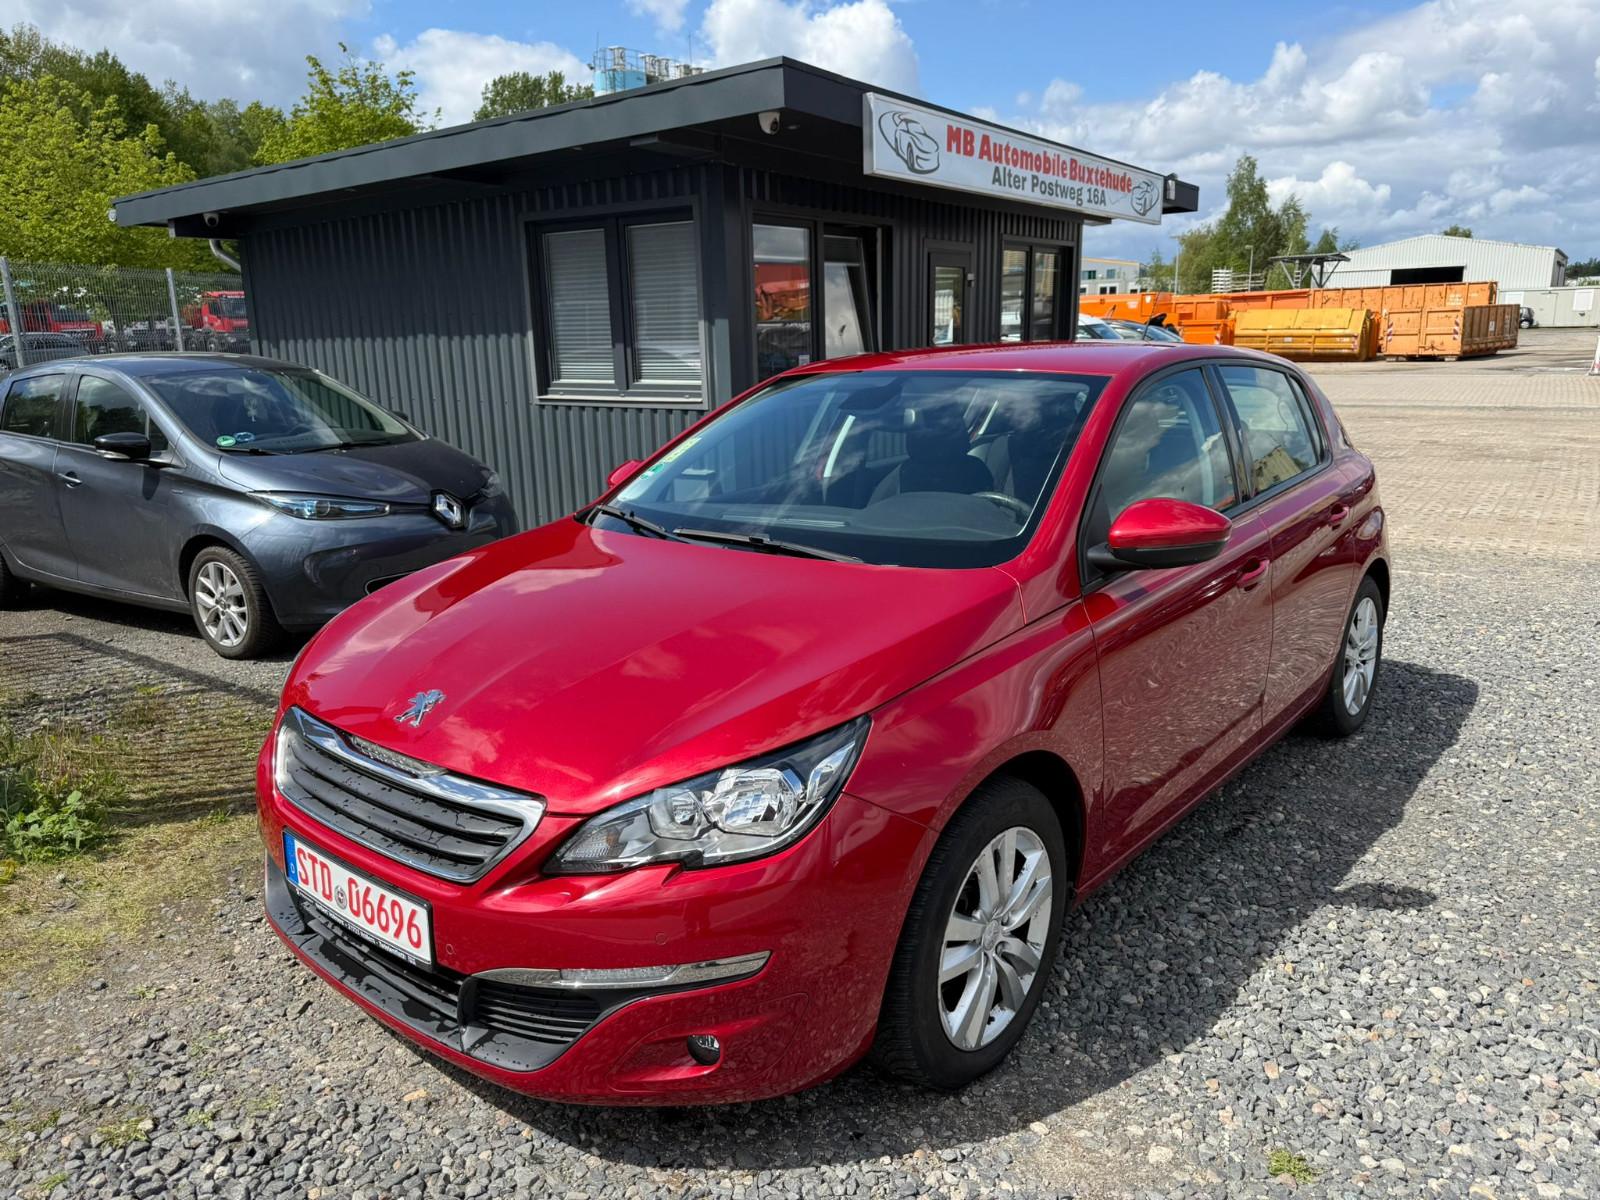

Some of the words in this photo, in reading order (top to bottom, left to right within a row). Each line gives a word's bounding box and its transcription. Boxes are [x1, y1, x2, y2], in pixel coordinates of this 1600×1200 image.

[946, 124, 975, 157] MB
[978, 134, 1067, 178] Automobile
[1069, 157, 1132, 193] Buxtehude
[992, 165, 1028, 190] Alter
[1031, 174, 1083, 206] Postweg
[1087, 187, 1107, 206] 16A
[297, 847, 333, 901] STD
[348, 877, 422, 949] 06696
